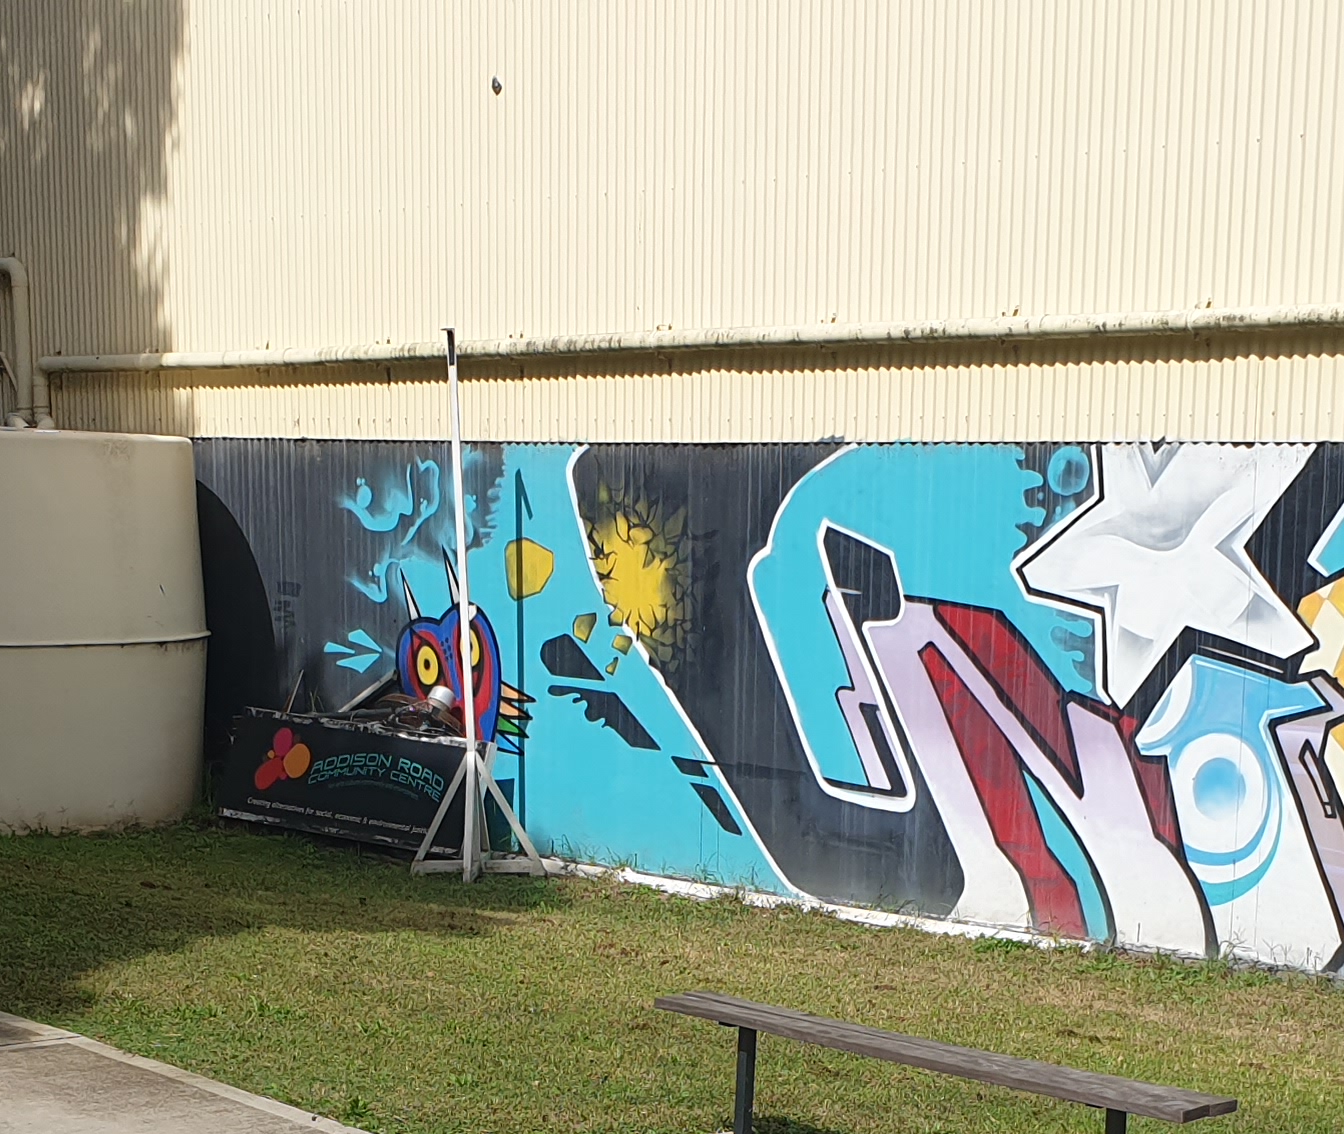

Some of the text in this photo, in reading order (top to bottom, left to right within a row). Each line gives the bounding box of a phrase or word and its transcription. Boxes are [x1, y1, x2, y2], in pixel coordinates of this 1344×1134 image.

[308, 767, 386, 784] COMMUNITY
[390, 771, 441, 802] CENTRE
[311, 753, 392, 774] ADDISON
[398, 758, 445, 792] ROAD
